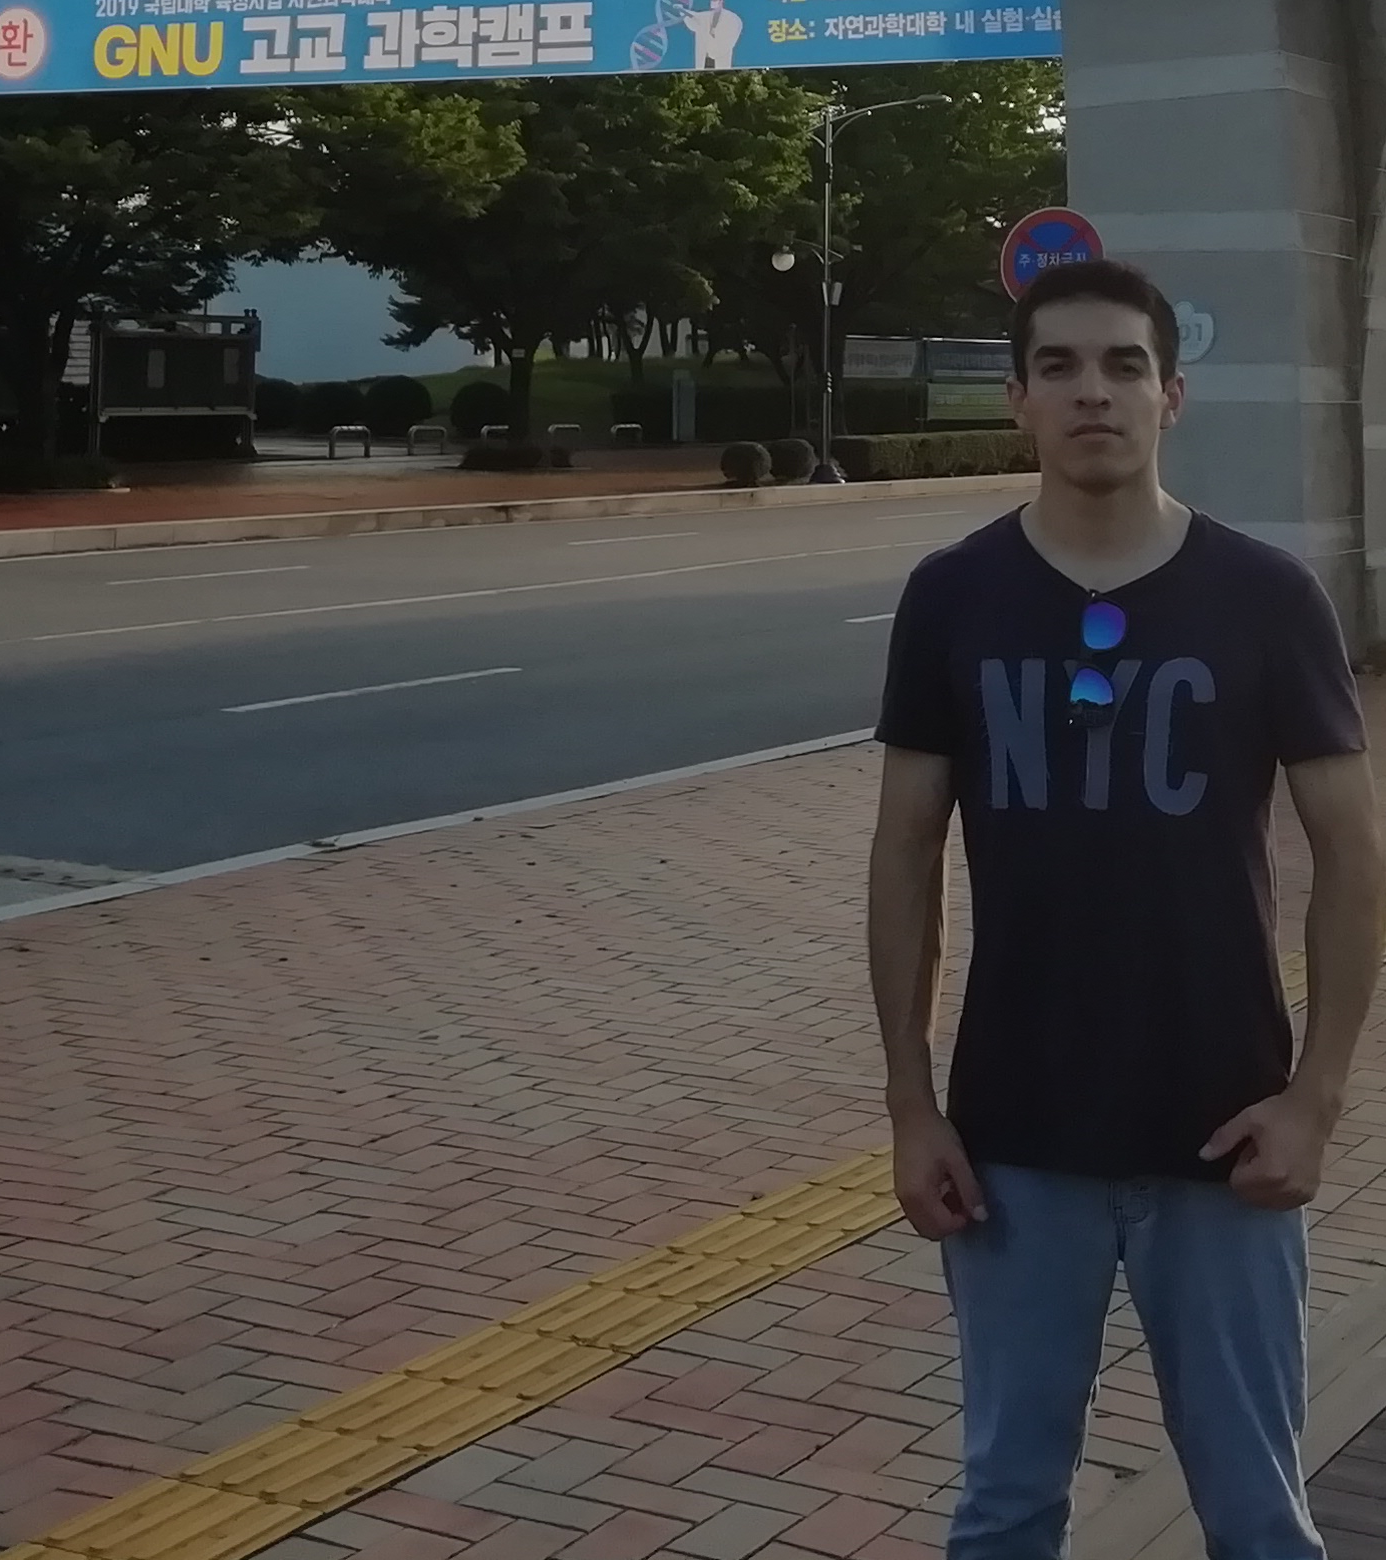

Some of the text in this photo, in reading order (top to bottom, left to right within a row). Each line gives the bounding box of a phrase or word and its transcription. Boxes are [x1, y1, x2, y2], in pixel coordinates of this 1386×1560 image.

[93, 1, 594, 79] GNU 고교 과학캠프
[768, 17, 815, 42] 장소:
[824, 11, 948, 40] 자연과학대학
[955, 9, 975, 34] 내
[980, 656, 1216, 817] NYC
